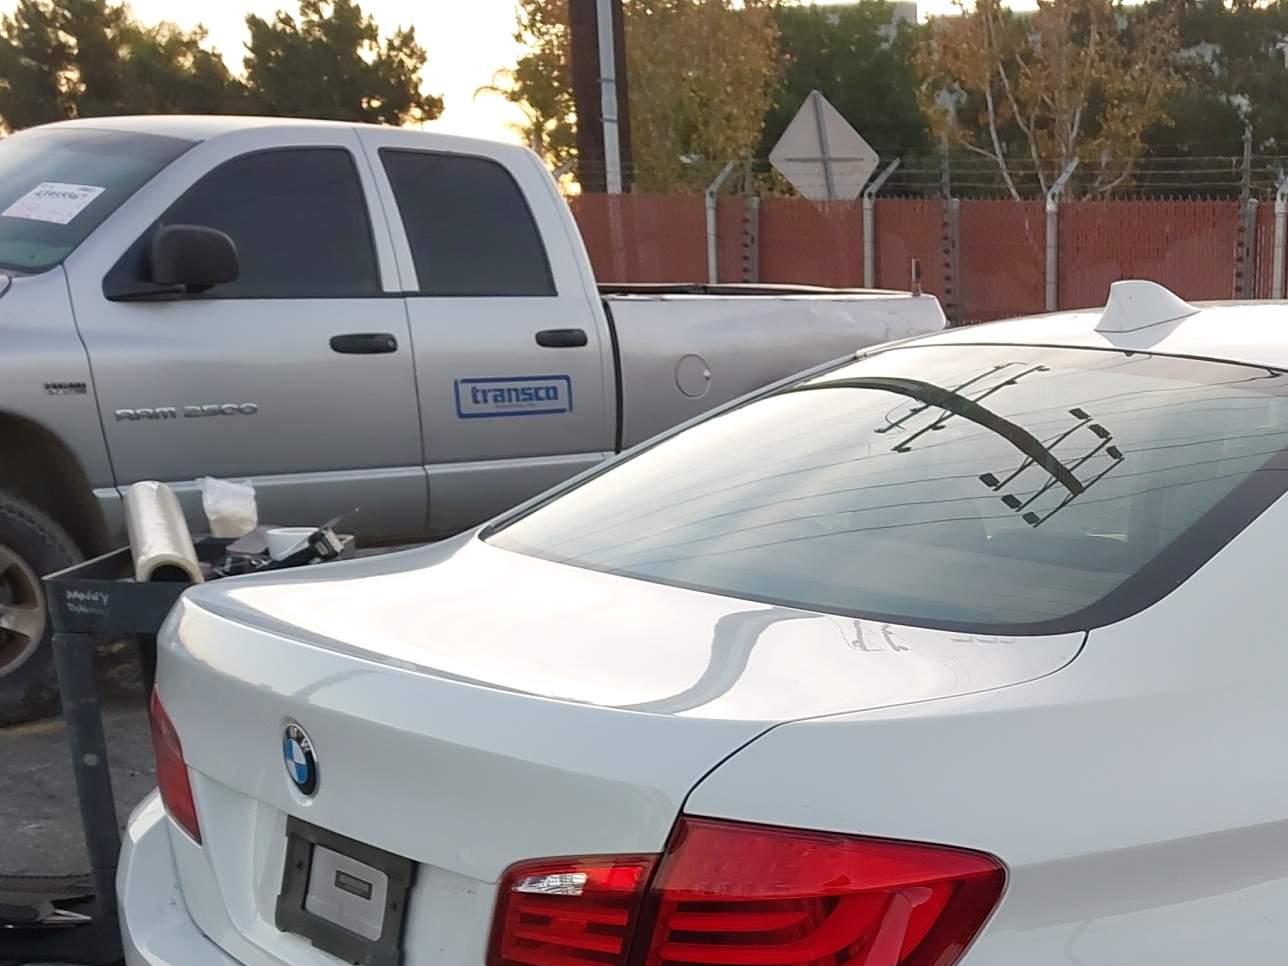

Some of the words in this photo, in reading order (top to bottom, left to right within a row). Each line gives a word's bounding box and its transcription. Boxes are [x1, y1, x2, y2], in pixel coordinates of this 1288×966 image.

[471, 386, 558, 404] transco
[115, 406, 176, 421] RAM
[183, 402, 258, 418] 2500
